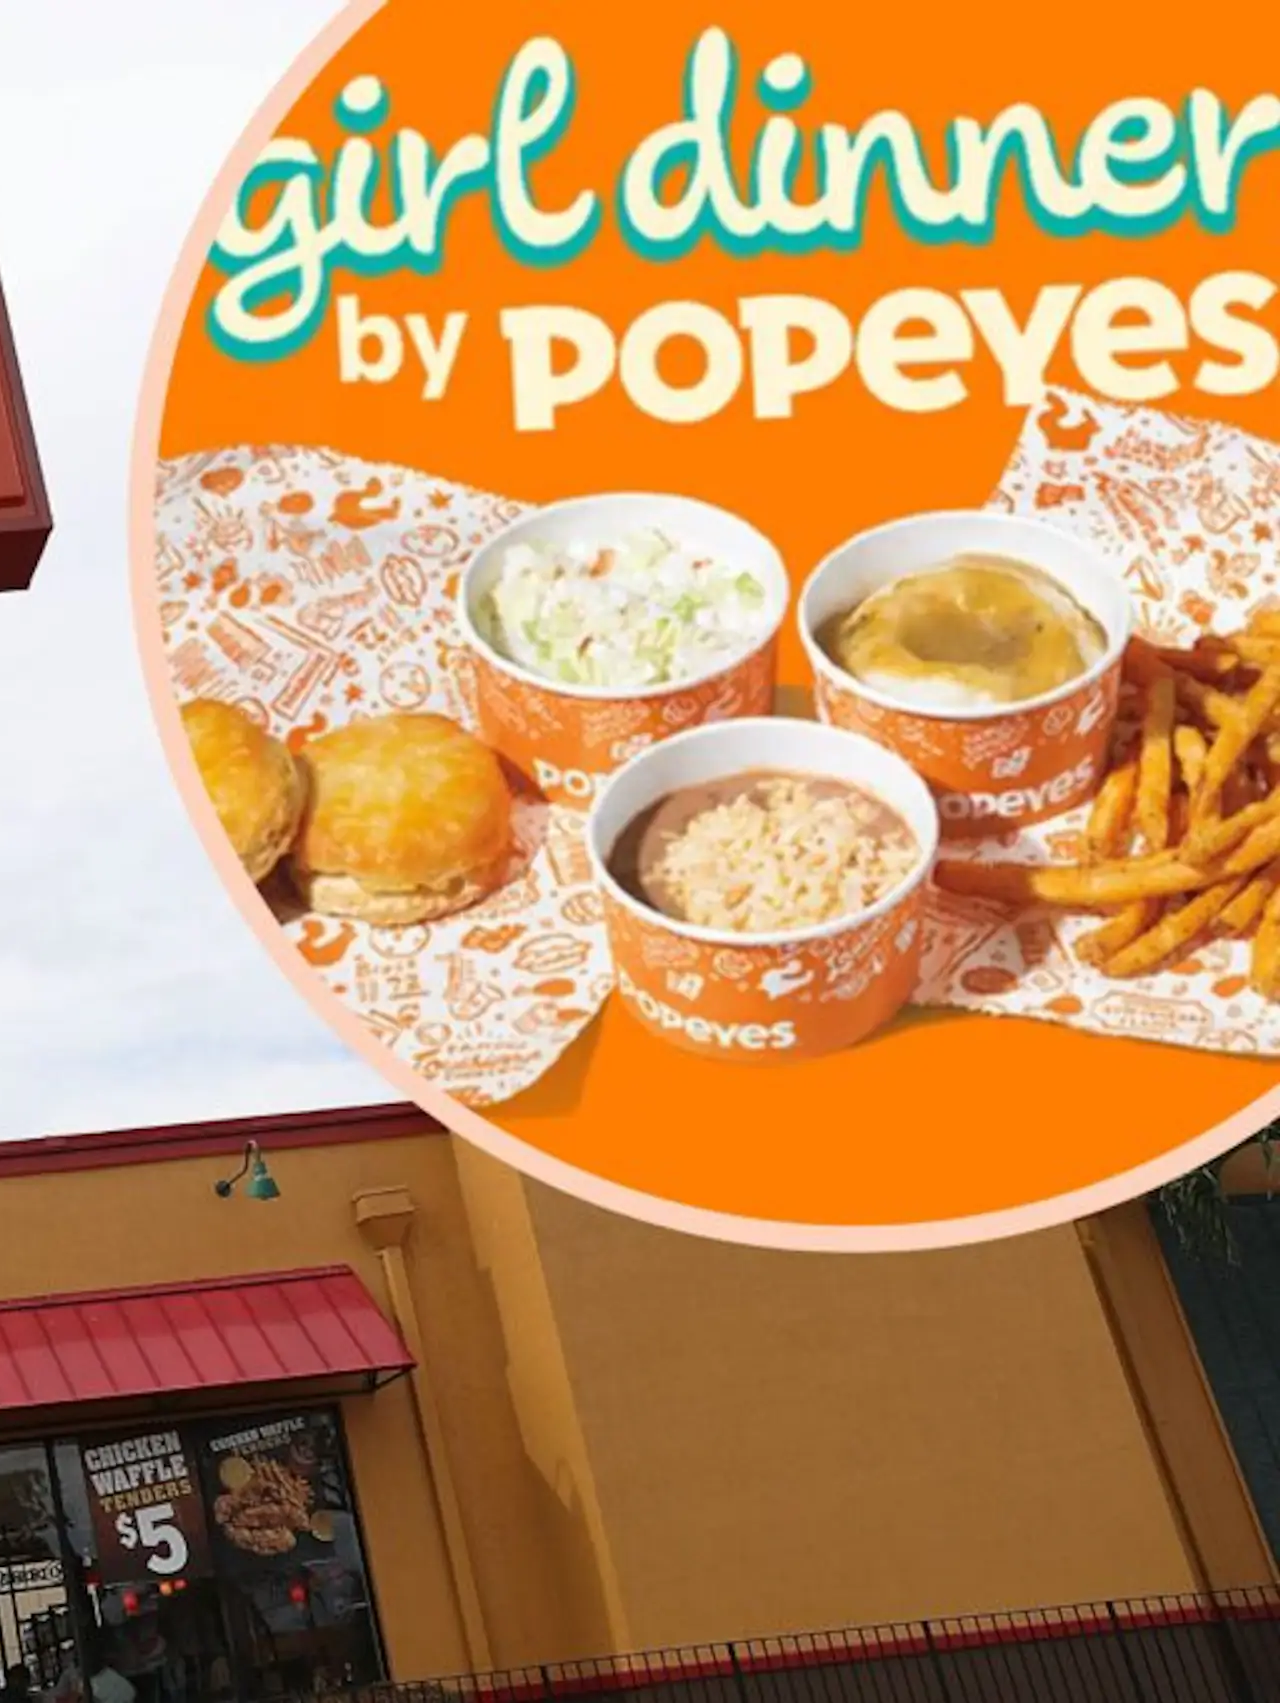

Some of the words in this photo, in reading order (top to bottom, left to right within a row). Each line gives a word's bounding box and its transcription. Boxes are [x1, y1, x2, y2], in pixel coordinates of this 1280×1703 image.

[938, 754, 1094, 820] OPEYES
[84, 1429, 182, 1471] CHICKEN
[90, 1454, 189, 1497] WAFFLE
[100, 1478, 192, 1513] TENDERS
[115, 1502, 189, 1575] $5
